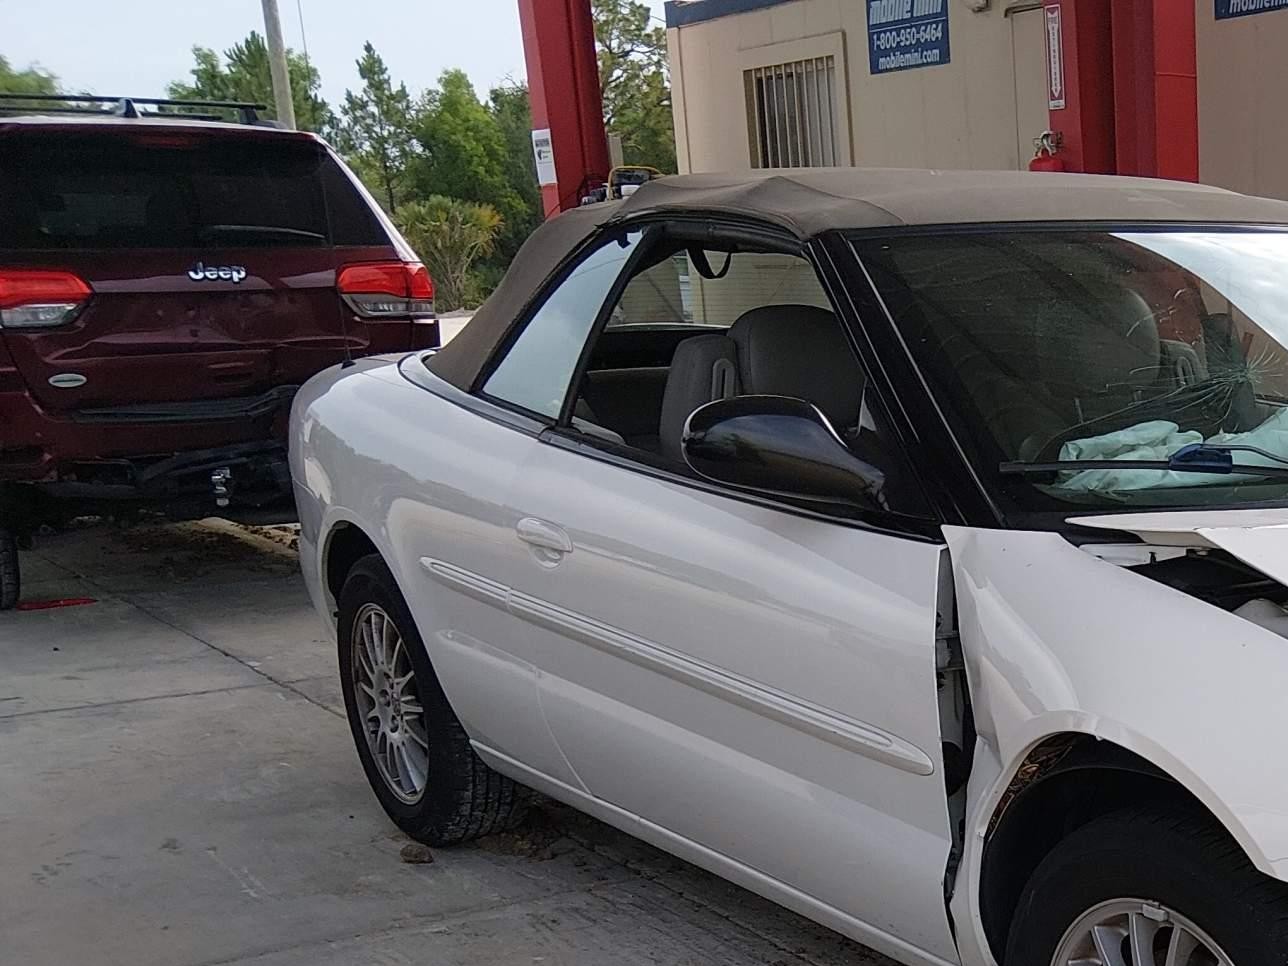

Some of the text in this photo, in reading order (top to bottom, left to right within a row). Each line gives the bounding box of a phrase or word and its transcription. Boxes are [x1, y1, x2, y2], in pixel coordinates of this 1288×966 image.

[873, 23, 943, 51] 1-800-950-6464
[879, 47, 940, 70] mobilemini.com
[187, 261, 247, 283] Jeep
